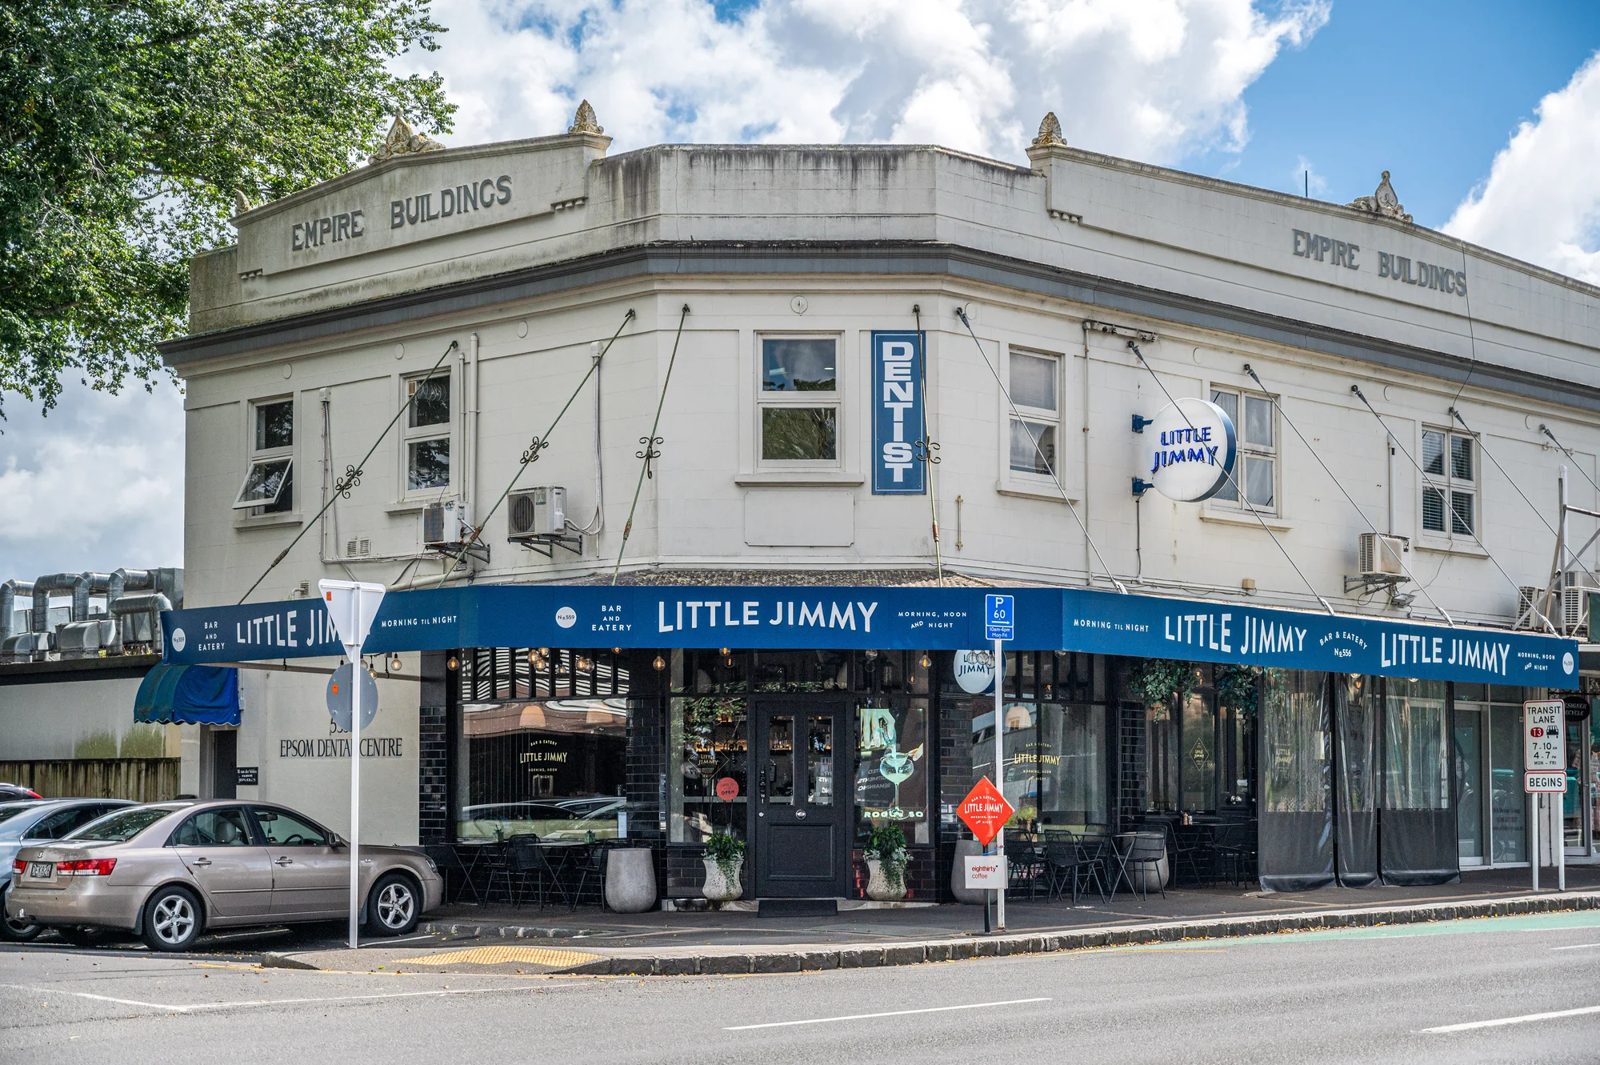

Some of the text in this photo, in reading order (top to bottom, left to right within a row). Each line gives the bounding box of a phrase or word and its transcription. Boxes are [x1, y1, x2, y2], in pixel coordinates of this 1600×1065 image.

[291, 174, 513, 251] EMPIRE BUILDINGS
[1292, 228, 1467, 297] EMPIRE BUILDINGS
[882, 341, 914, 483] DENTIST
[1160, 426, 1212, 446] LITTLE
[1151, 445, 1219, 474] JIMMY
[995, 597, 1004, 609] P
[658, 601, 878, 633] LITTLE JIMMY
[993, 609, 1006, 619] 60
[204, 621, 218, 629] BAR
[381, 617, 418, 628] MORNING
[432, 615, 457, 625] NIGHT
[591, 624, 632, 632] EATERY
[910, 620, 924, 630] AND
[1073, 618, 1149, 633] MORNING TIL NIGHT
[236, 609, 344, 648] LITTLE JIM
[1165, 613, 1307, 655] LITTLE JIMMY
[198, 642, 225, 652] EATERY
[1319, 631, 1368, 650] BAR & EATERY
[1381, 632, 1511, 676] LITTLE JIMMY
[1517, 652, 1541, 660] MORNING,
[958, 665, 991, 678] JIMMY
[1527, 706, 1561, 715] TRANSIT
[1533, 715, 1556, 724] LANE
[1532, 728, 1542, 737] T3
[280, 737, 403, 757] EPSOM DENTA CENTRE
[519, 752, 568, 764] LITTLE JIMMY
[1014, 753, 1061, 766] LITTLE JIMMY
[1529, 777, 1563, 787] BEGINS
[964, 803, 1004, 814] LITTLE JIMMY
[971, 865, 996, 874] eighthirty
